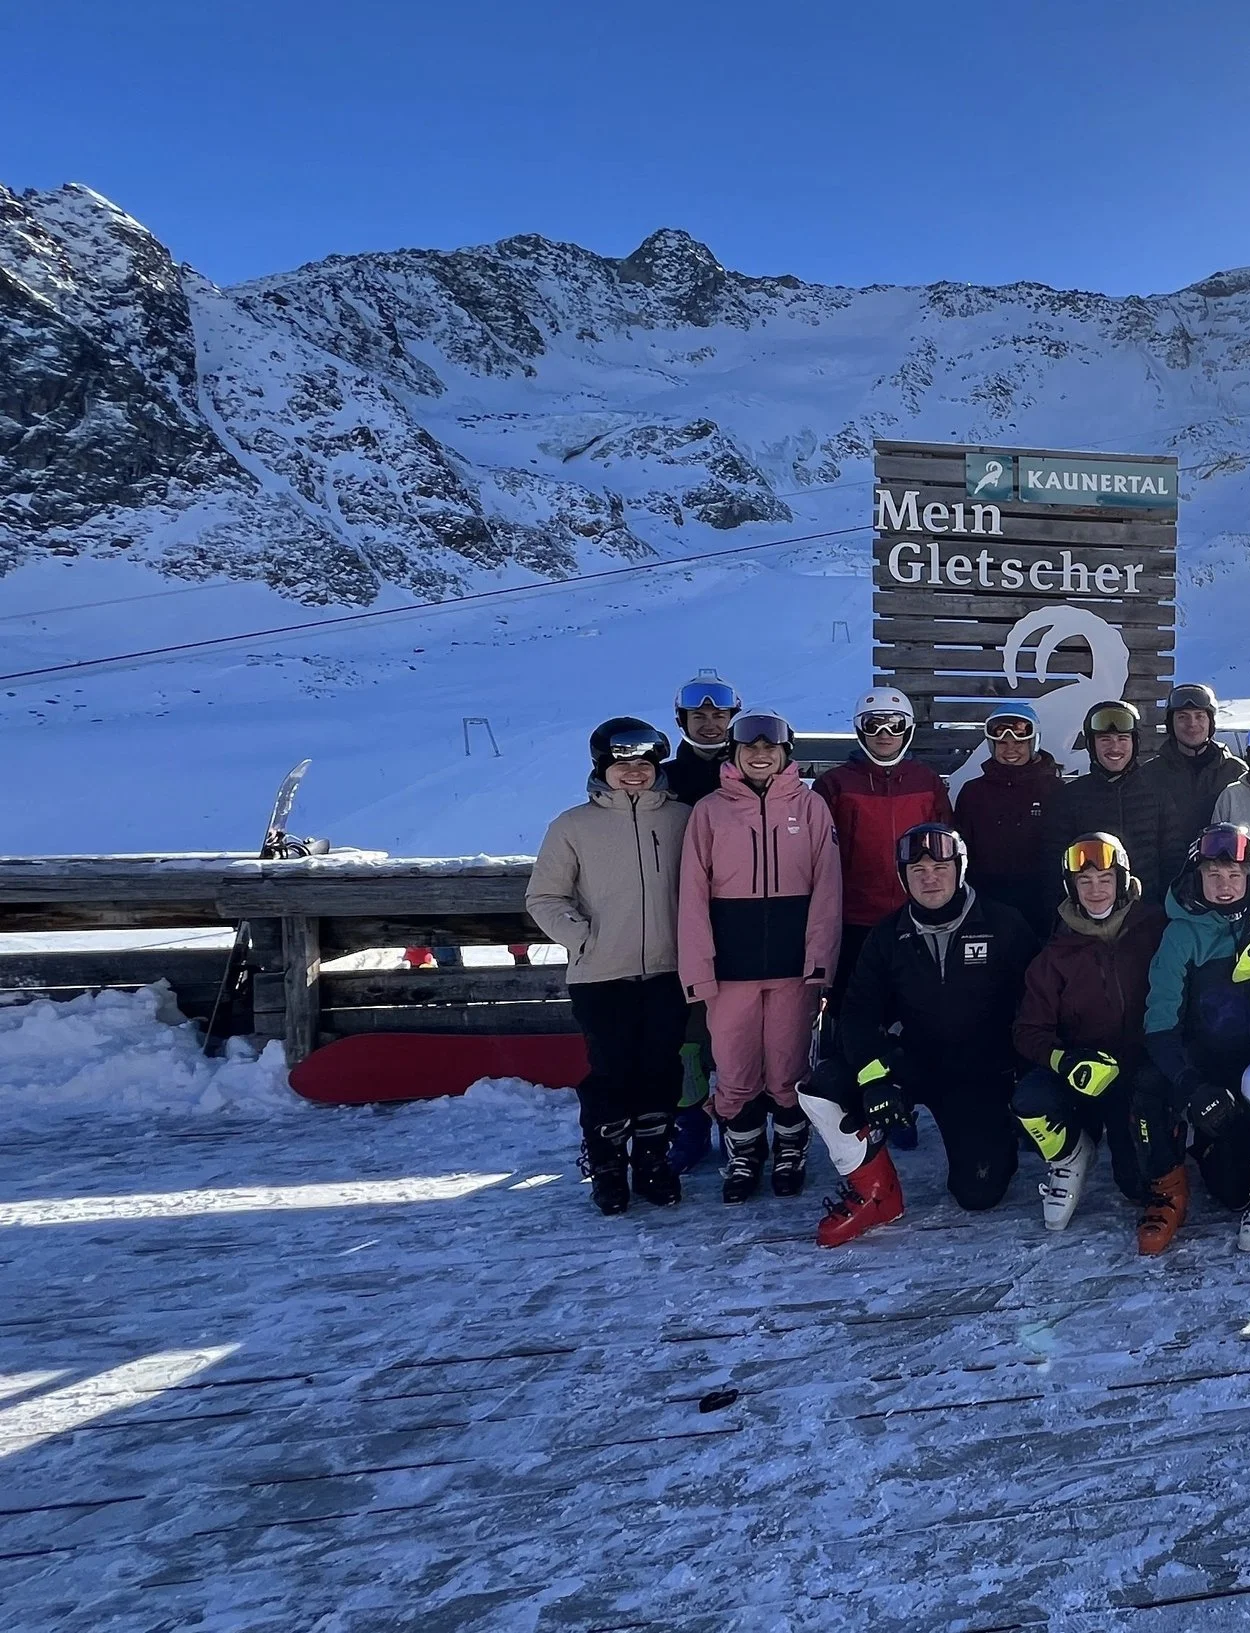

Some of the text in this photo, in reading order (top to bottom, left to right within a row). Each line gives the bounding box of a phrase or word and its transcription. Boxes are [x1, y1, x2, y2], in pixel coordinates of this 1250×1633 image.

[1027, 470, 1169, 495] KAUNERTAL
[874, 489, 1004, 536] Mein
[888, 541, 1145, 594] Gletscher
[869, 1100, 889, 1113] LEKI
[1200, 1099, 1220, 1117] LEKI
[1140, 1118, 1150, 1143] LEKI
